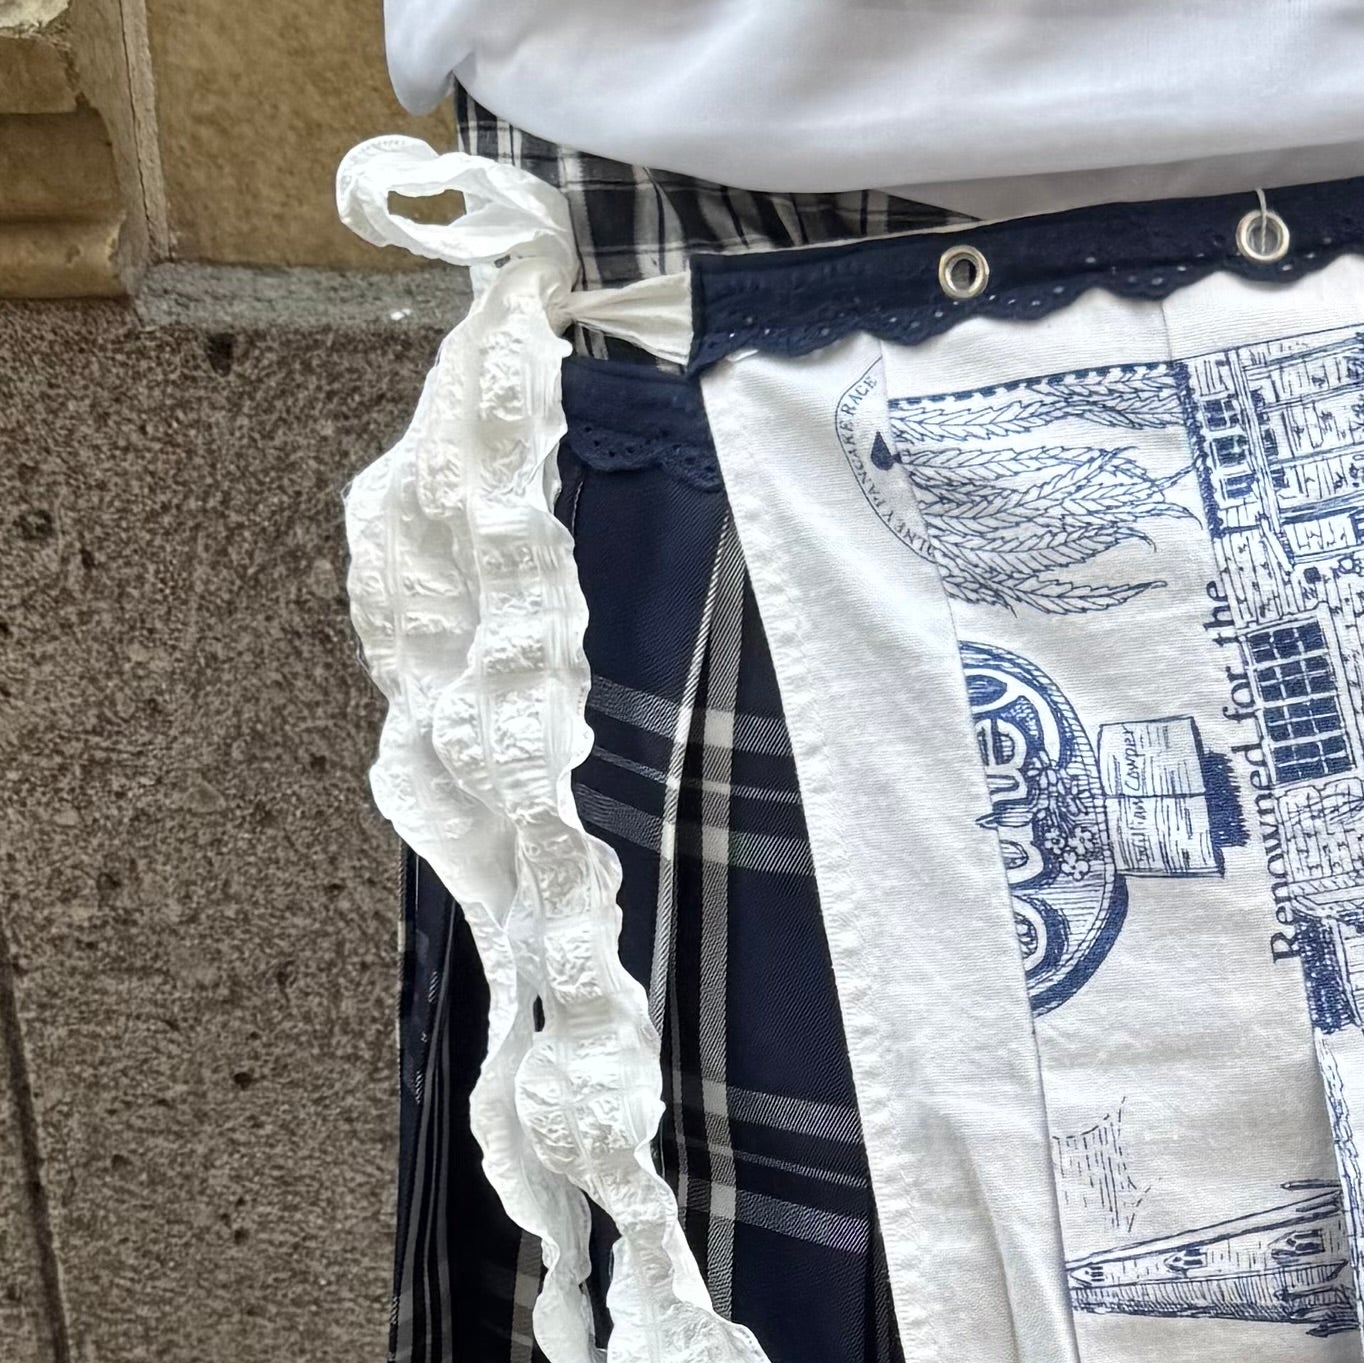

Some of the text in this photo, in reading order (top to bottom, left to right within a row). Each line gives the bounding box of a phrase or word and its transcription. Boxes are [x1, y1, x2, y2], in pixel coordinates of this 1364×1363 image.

[840, 373, 879, 417] RACE
[1120, 724, 1147, 793] Cowper
[1203, 580, 1300, 964] Renowned for the
